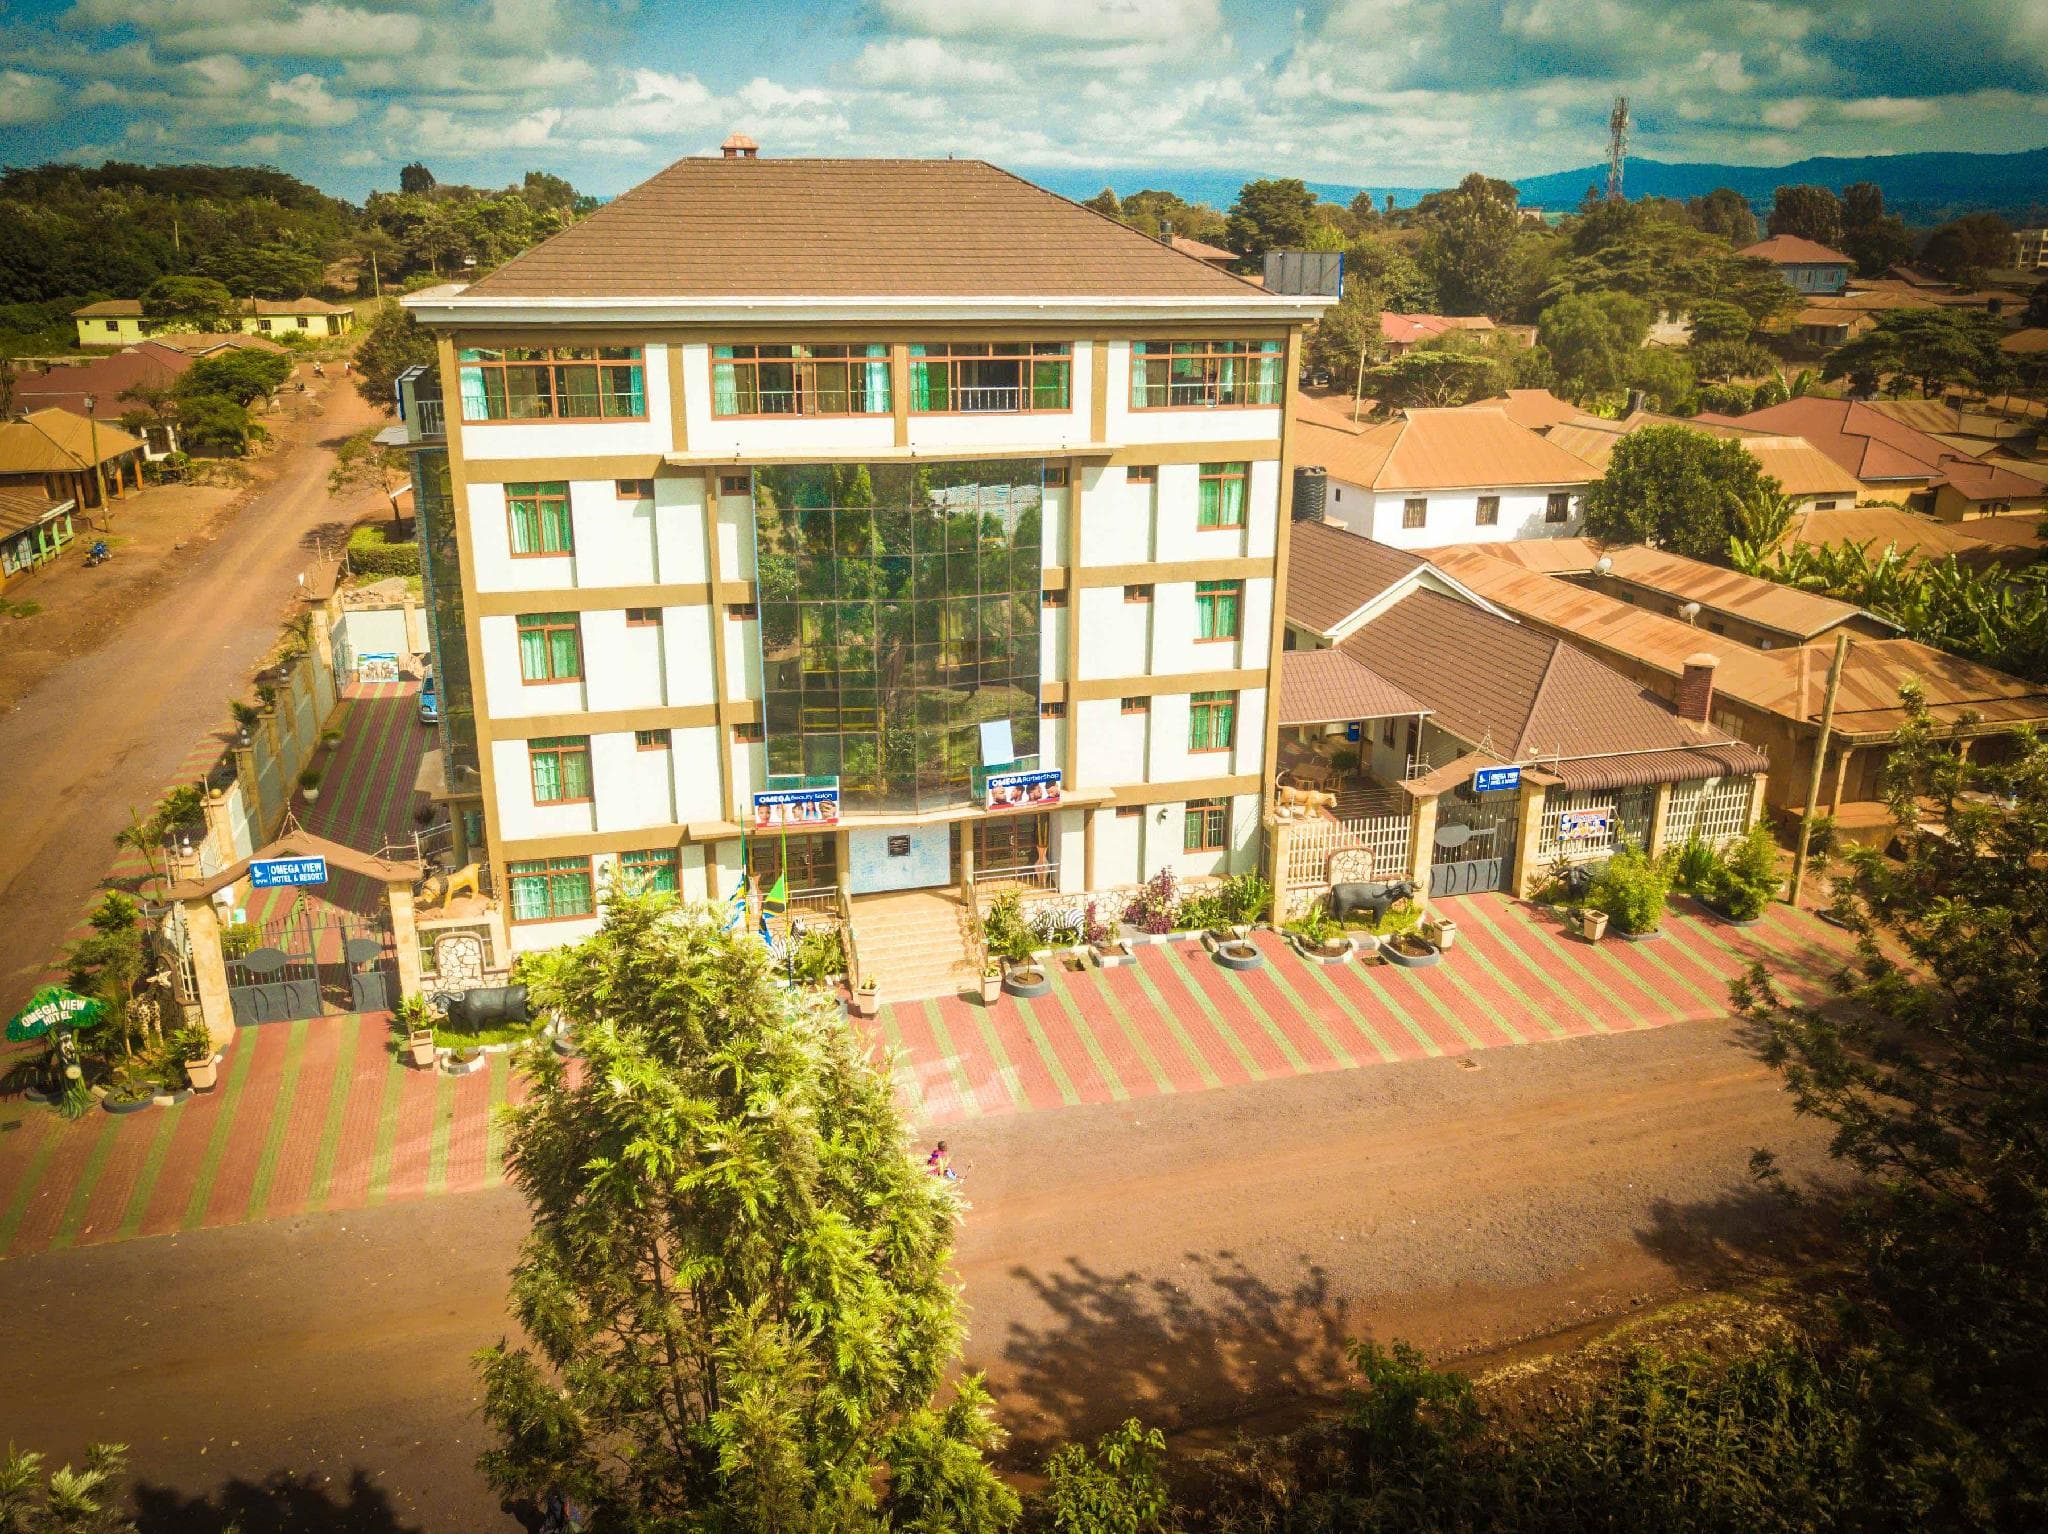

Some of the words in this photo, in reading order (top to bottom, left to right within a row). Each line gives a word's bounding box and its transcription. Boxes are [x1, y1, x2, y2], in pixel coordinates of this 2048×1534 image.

[991, 775, 1023, 787] OMEGA
[758, 794, 791, 803] OMEGA
[270, 863, 300, 875] OMEGA
[301, 862, 322, 873] VIEW
[271, 874, 293, 884] HOTEL
[293, 873, 299, 882] &
[299, 872, 324, 882] RESORT
[21, 1002, 59, 1027] OMEGA
[59, 999, 87, 1011] VIEW
[42, 1010, 73, 1026] HOTEL
